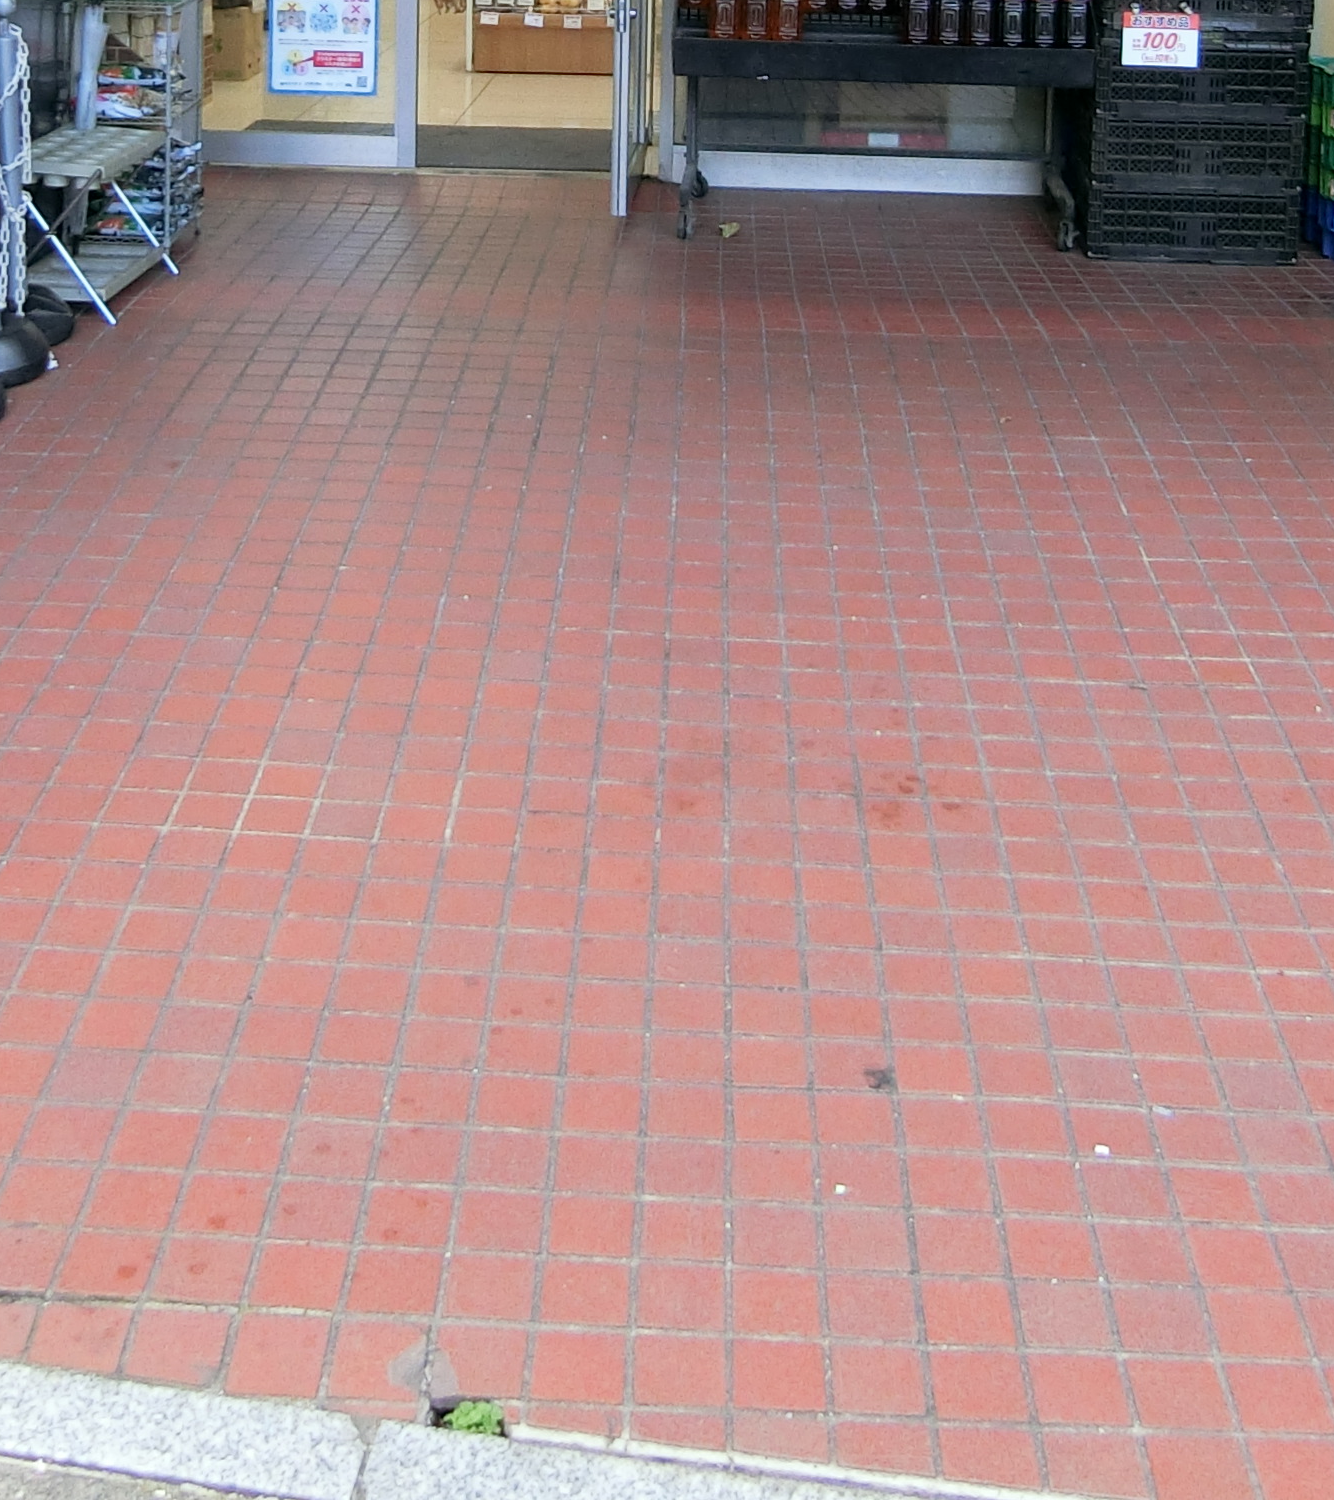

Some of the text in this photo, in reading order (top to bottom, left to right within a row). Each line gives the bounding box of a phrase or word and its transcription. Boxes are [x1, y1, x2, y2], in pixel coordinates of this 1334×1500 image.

[1131, 15, 1190, 28] おすすめ品
